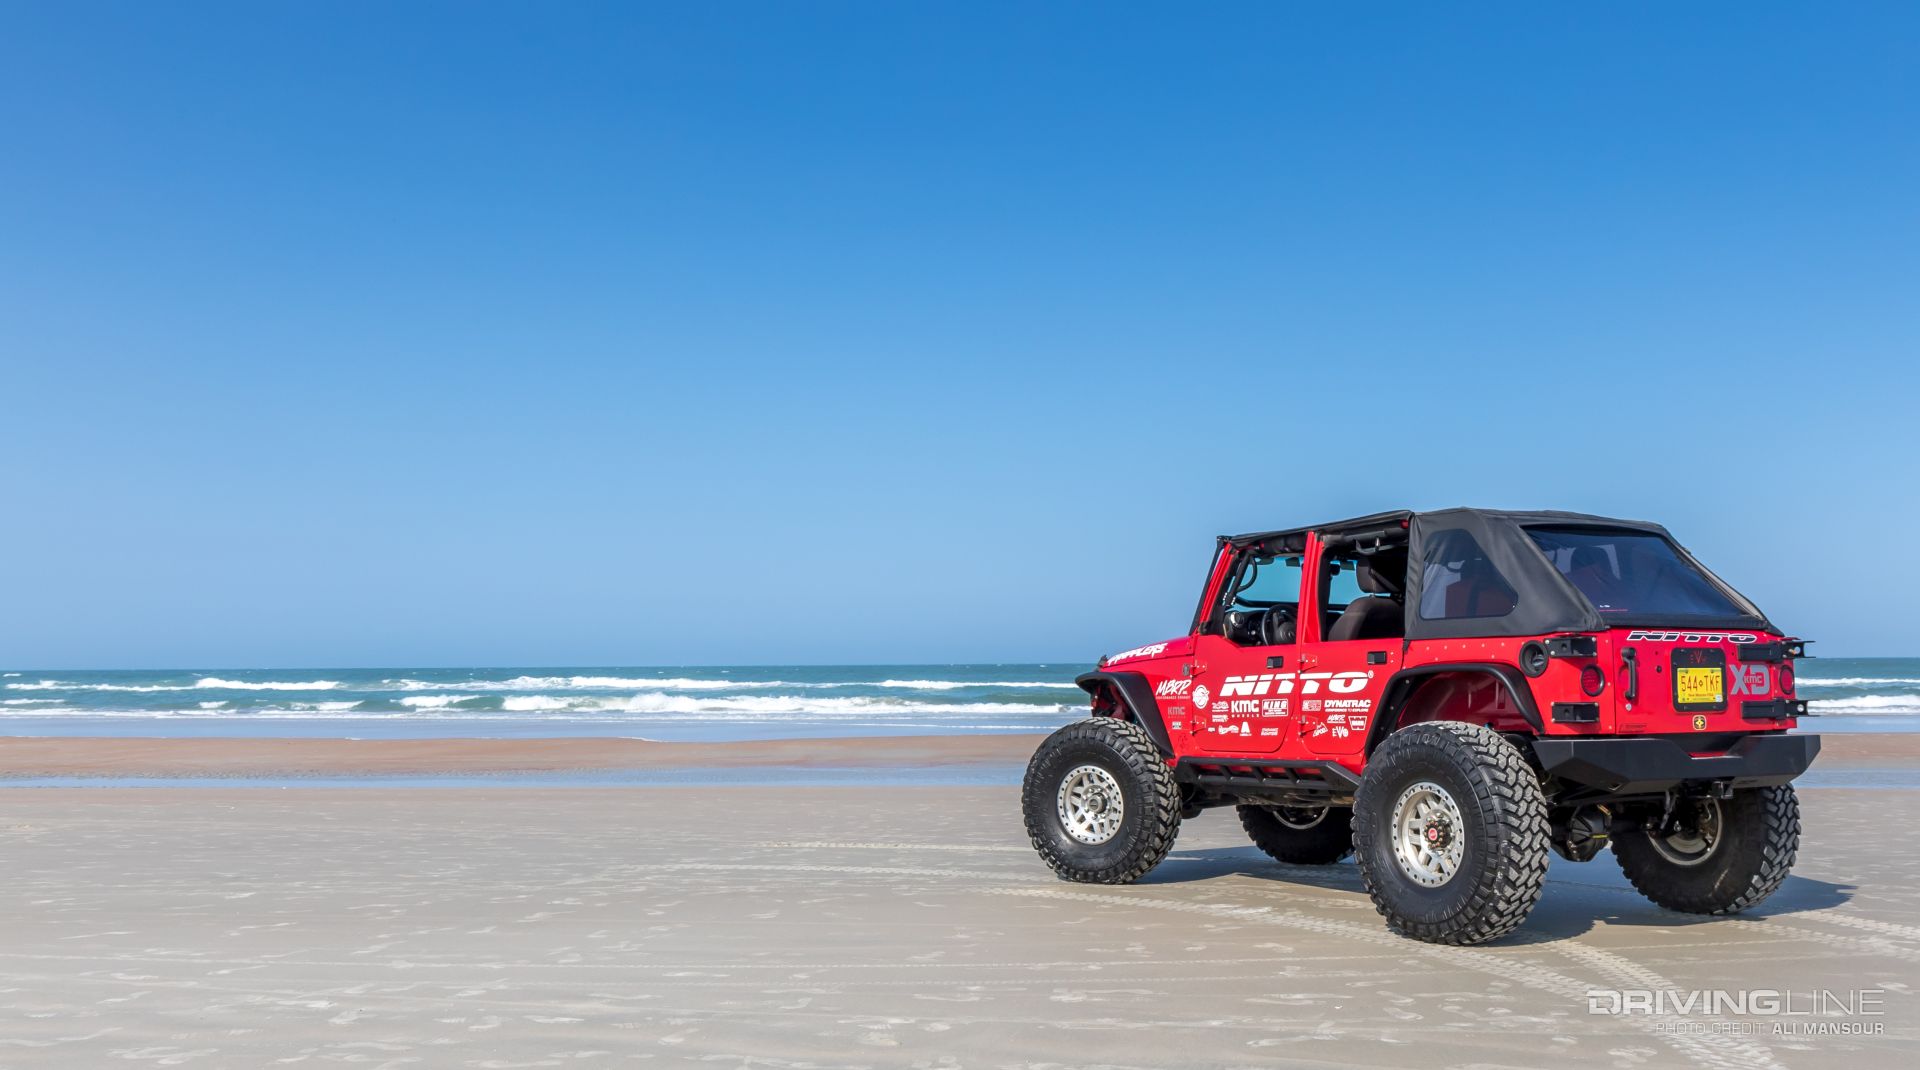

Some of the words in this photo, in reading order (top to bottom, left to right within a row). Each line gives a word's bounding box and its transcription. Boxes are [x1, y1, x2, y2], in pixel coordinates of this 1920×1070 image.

[1627, 630, 1758, 644] NITTO
[1219, 671, 1370, 697] NITTO
[1680, 675, 1698, 692] 544
[1703, 675, 1720, 692] TKF
[1729, 664, 1771, 695] XD
[1156, 679, 1192, 697] MBRP
[1231, 699, 1259, 713] KMC
[1263, 700, 1287, 709] KING
[1324, 699, 1371, 708] DYNATRAC
[1167, 706, 1185, 716] KMC
